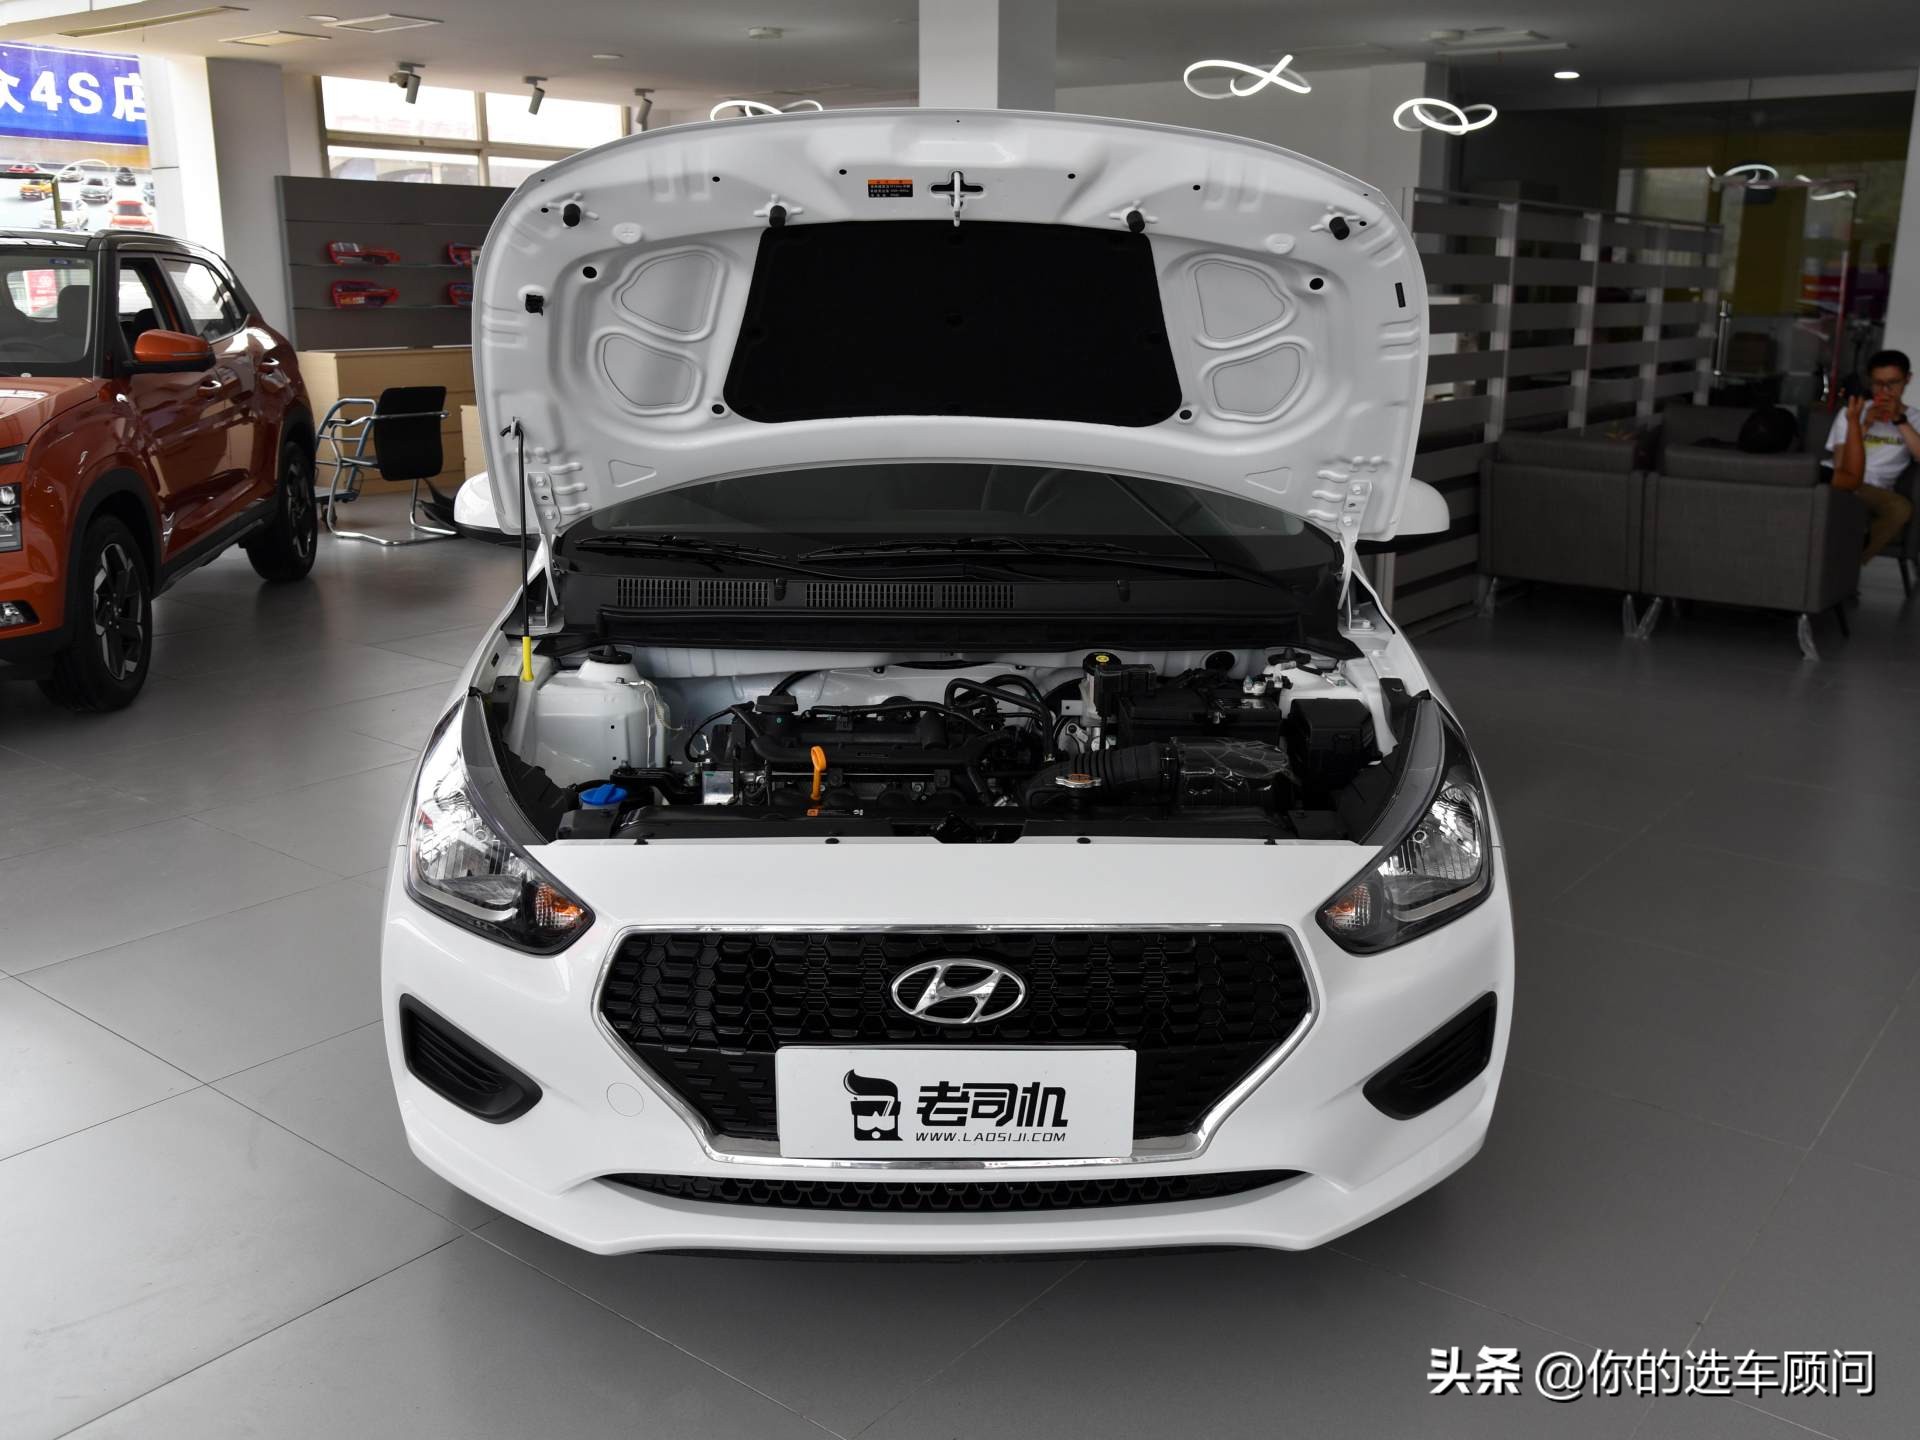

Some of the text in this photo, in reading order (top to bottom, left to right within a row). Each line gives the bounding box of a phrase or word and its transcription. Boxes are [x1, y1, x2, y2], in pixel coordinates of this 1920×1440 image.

[916, 1081, 1068, 1127] 老司机
[915, 1132, 1066, 1142] WWW.LAOSIJI.COM
